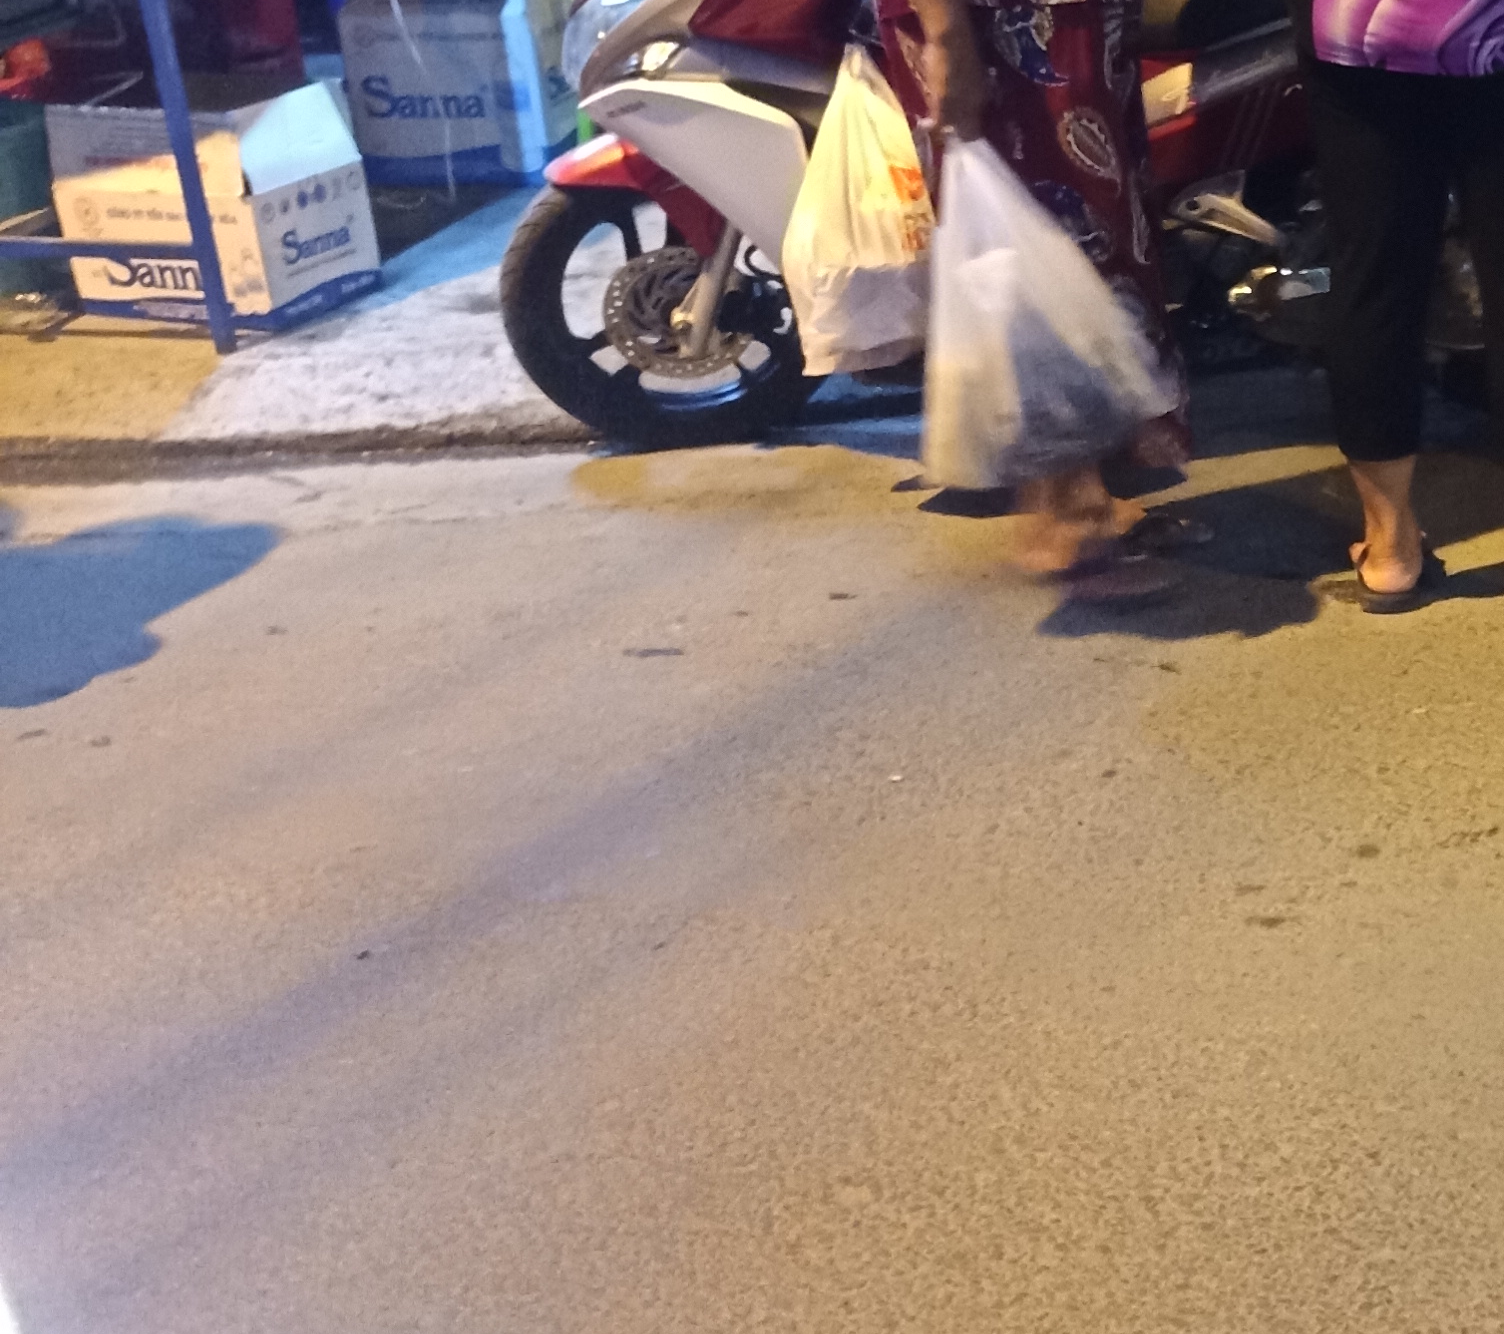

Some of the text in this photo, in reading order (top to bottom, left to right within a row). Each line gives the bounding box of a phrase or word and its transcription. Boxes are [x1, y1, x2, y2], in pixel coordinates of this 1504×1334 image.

[362, 75, 485, 118] Sanna
[281, 224, 351, 265] Sanna
[102, 257, 199, 291] Sann
